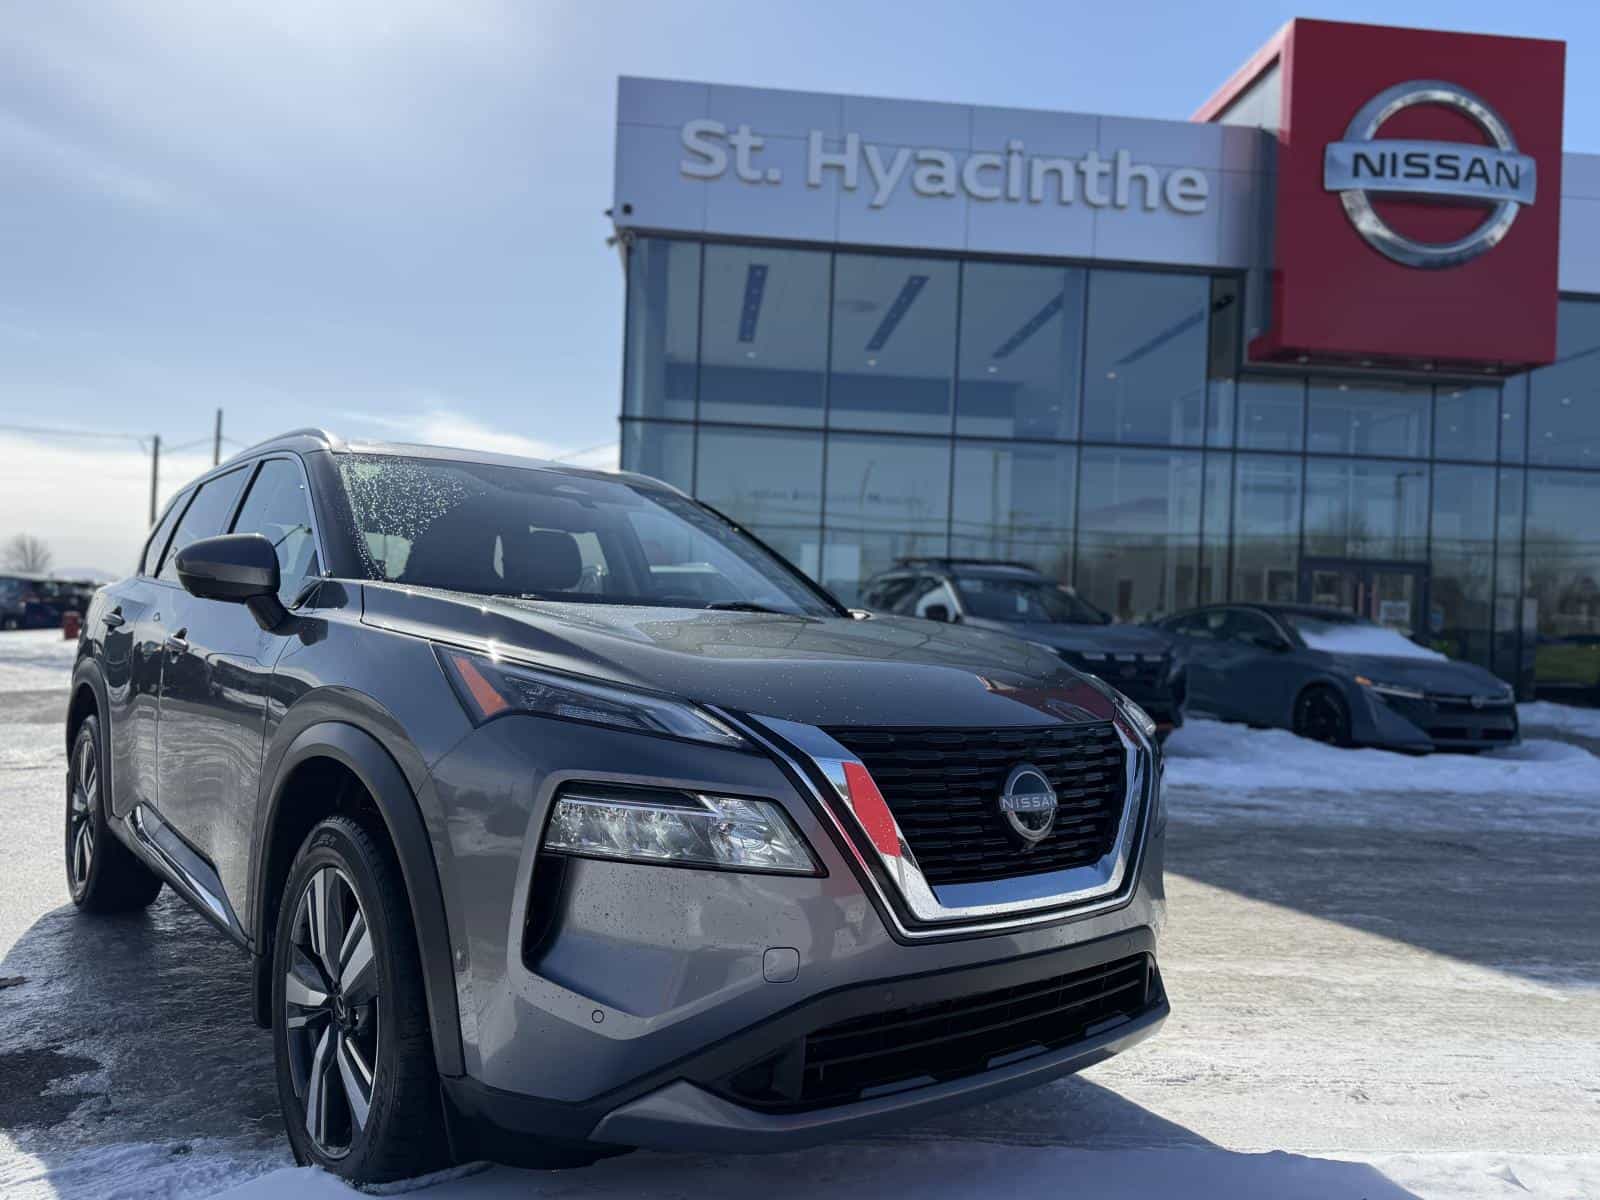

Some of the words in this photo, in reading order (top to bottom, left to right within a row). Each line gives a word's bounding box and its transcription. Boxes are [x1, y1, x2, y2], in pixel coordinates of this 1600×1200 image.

[680, 118, 781, 184] St.
[807, 131, 1210, 213] Hyacinthe
[1352, 152, 1520, 190] NISSAN
[1002, 795, 1056, 809] NISSAN
